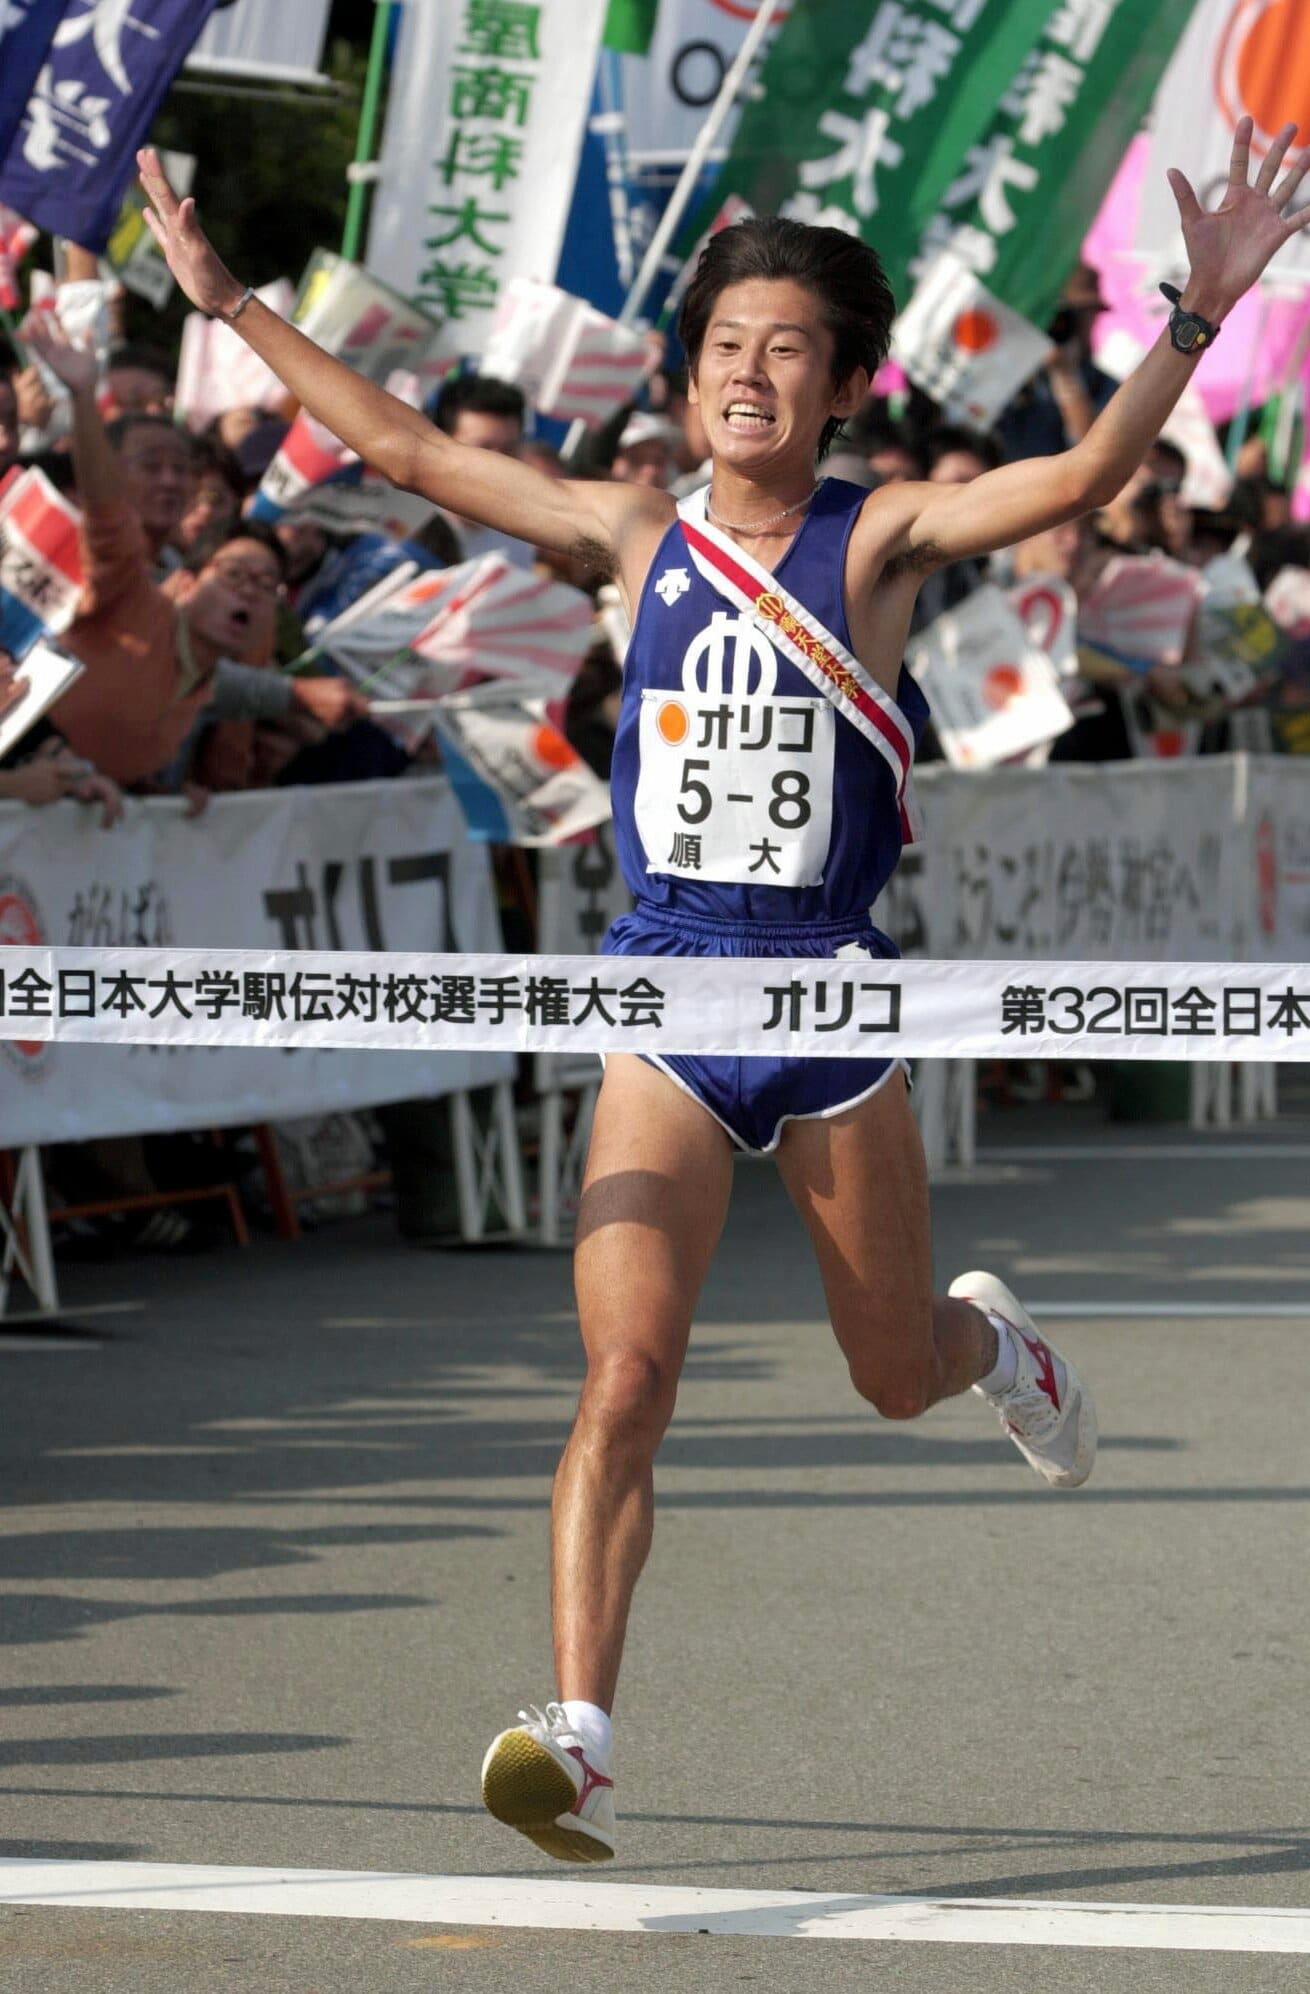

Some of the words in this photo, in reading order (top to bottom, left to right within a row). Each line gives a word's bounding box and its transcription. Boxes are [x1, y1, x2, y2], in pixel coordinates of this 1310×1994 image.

[697, 704, 815, 753] オリコ
[677, 758, 812, 829] 5-8
[0, 967, 666, 1028] 全日本大学駅伝対校選手権大会
[762, 980, 902, 1033] オリコ
[1000, 985, 1310, 1036] 第32回全日本
